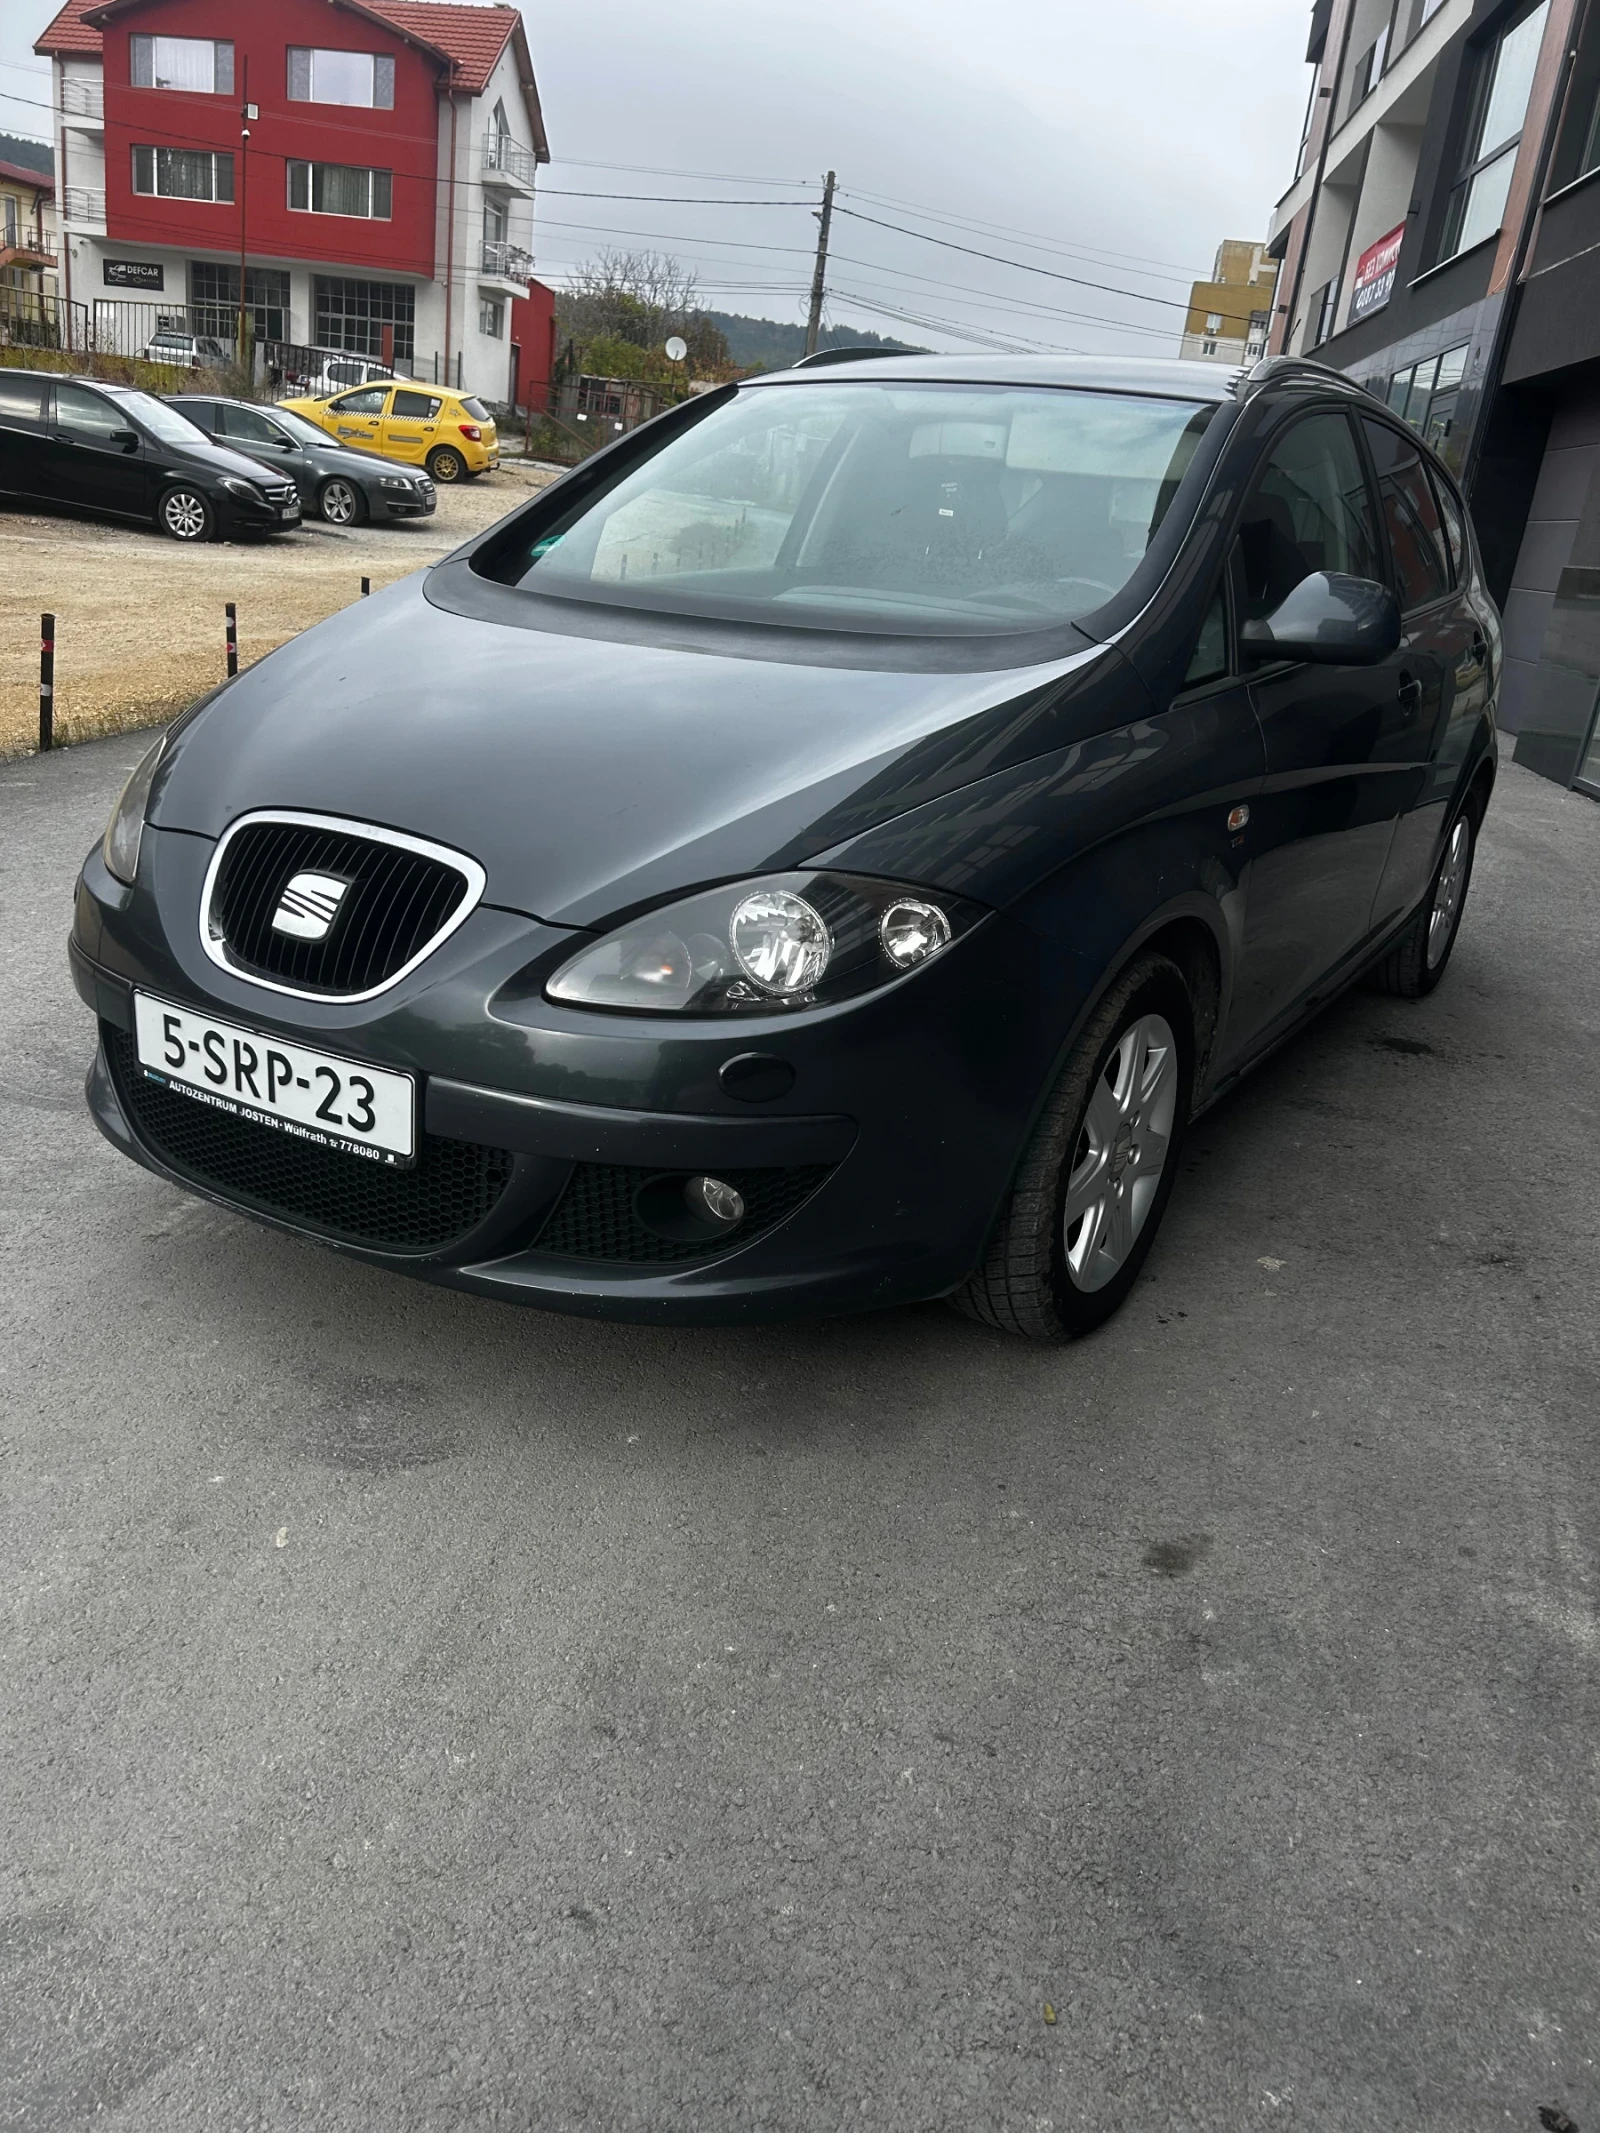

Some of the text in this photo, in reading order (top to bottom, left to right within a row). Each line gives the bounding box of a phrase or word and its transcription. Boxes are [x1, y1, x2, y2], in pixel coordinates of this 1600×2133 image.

[127, 265, 159, 277] DEFCAR
[162, 1013, 376, 1133] 5-SRP-23
[169, 1080, 238, 1114] AUTOZENTRUM
[239, 1107, 279, 1129] JOSTEN
[284, 1121, 327, 1145] Wülfrath
[339, 1139, 380, 1160] 778080
